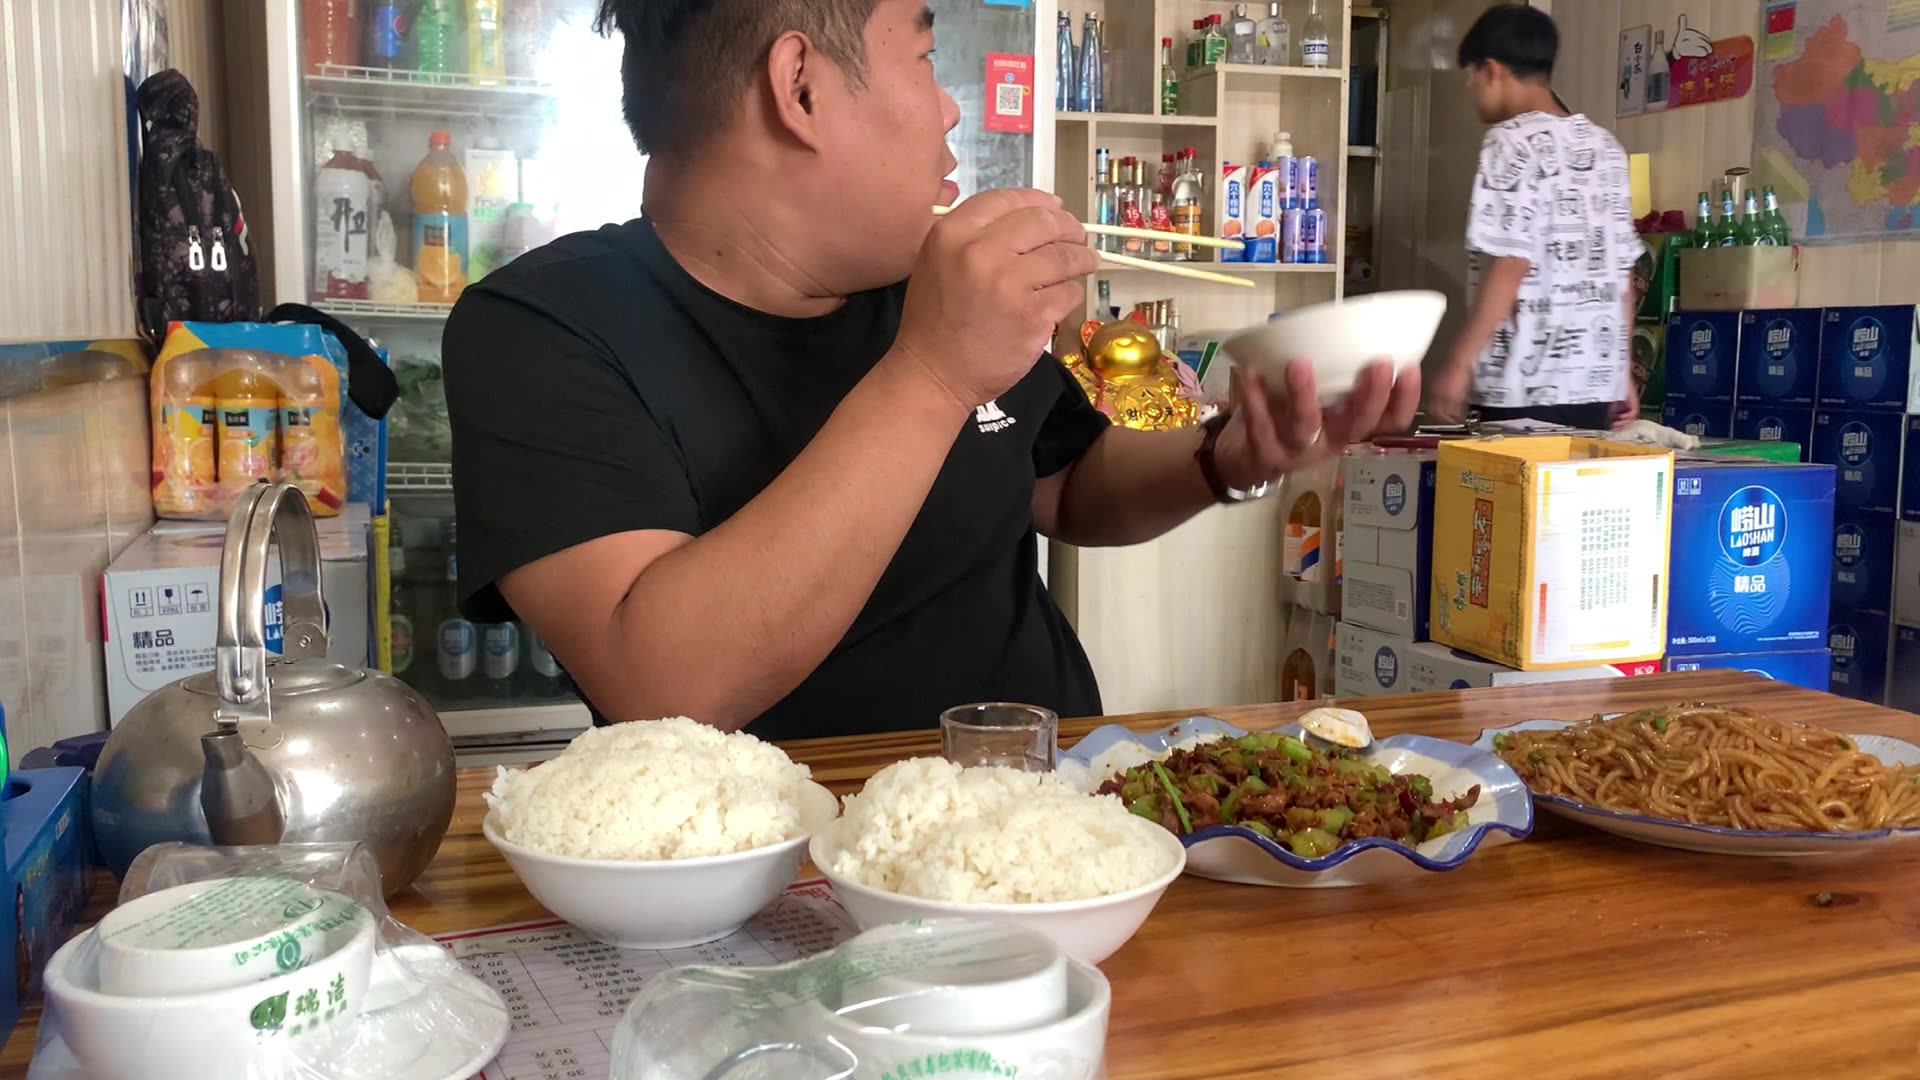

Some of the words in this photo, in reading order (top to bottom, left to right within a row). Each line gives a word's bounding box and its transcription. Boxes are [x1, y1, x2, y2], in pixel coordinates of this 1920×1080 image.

[1125, 209, 1139, 219] 15
[1153, 209, 1167, 219] 15
[1853, 327, 1878, 342] 崂山
[1843, 431, 1867, 446] 崂山
[1731, 502, 1775, 532] 崂山
[1730, 528, 1775, 548] LAOSHAN
[1734, 574, 1766, 593] 精品
[133, 629, 175, 649] 精品
[295, 972, 345, 1015] 瑞洁
[561, 1058, 579, 1066] 32
[566, 1069, 585, 1077] 35
